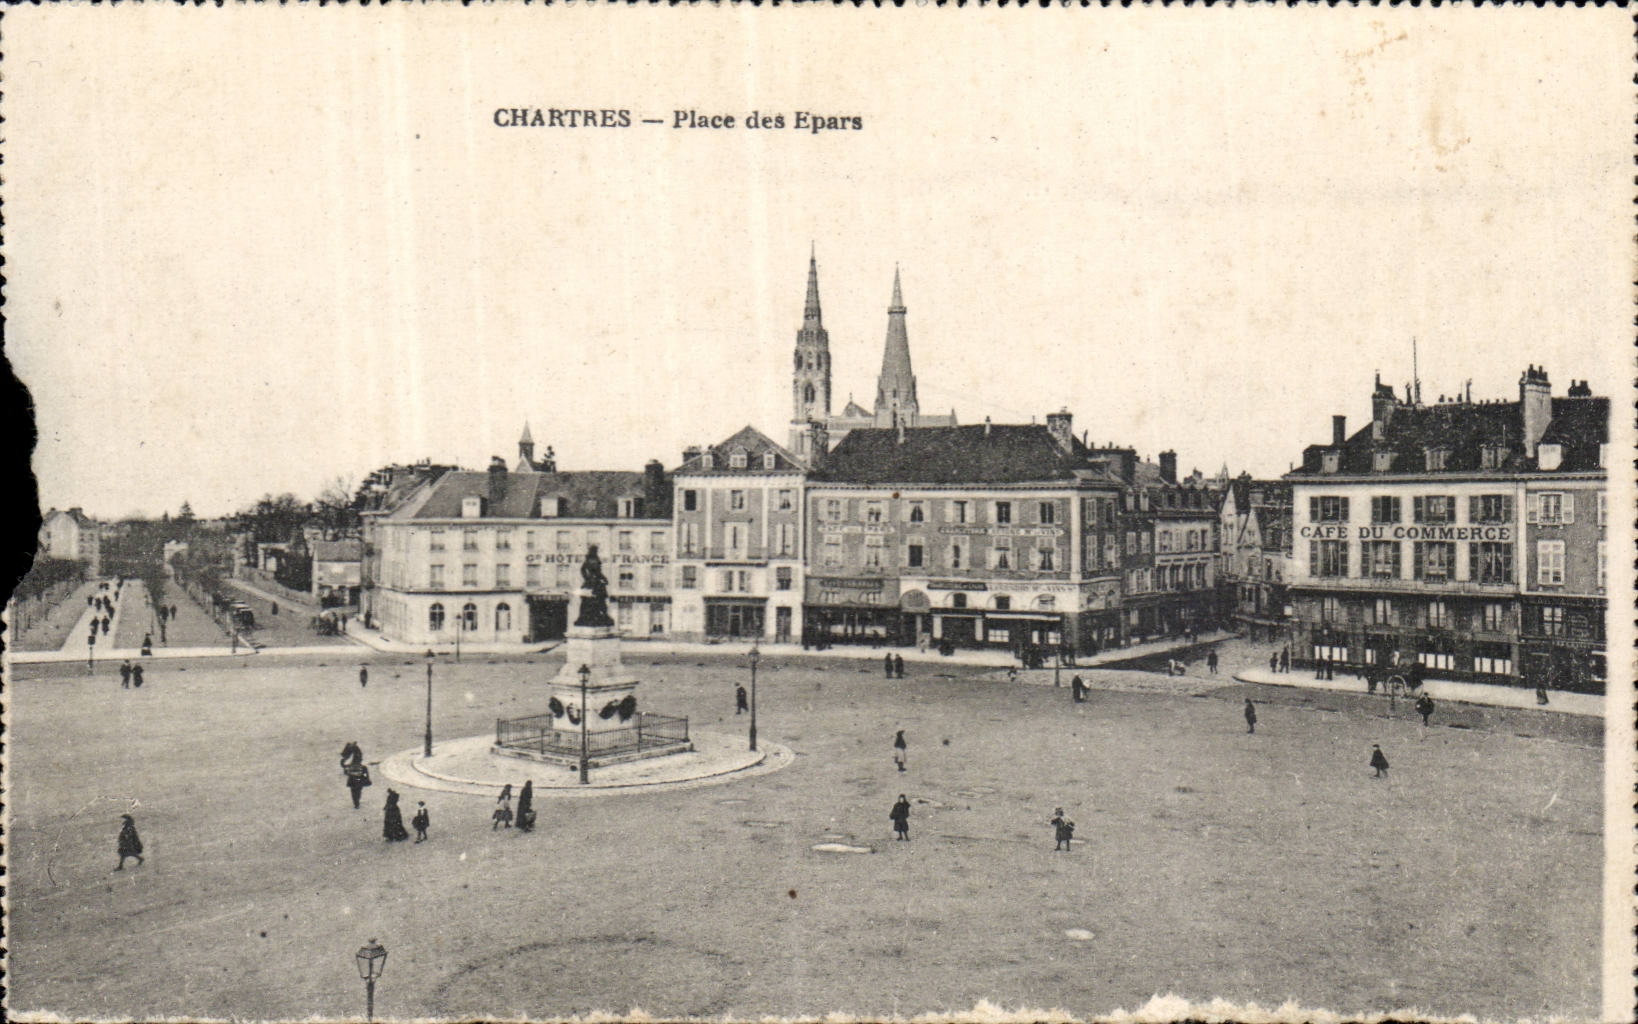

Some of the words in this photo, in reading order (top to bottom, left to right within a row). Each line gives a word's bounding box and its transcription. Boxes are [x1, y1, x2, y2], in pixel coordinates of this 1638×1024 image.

[1300, 526, 1348, 539] CAFE
[1358, 526, 1384, 539] DU
[1393, 526, 1510, 540] COMMERCE
[612, 554, 670, 564] FRANCE
